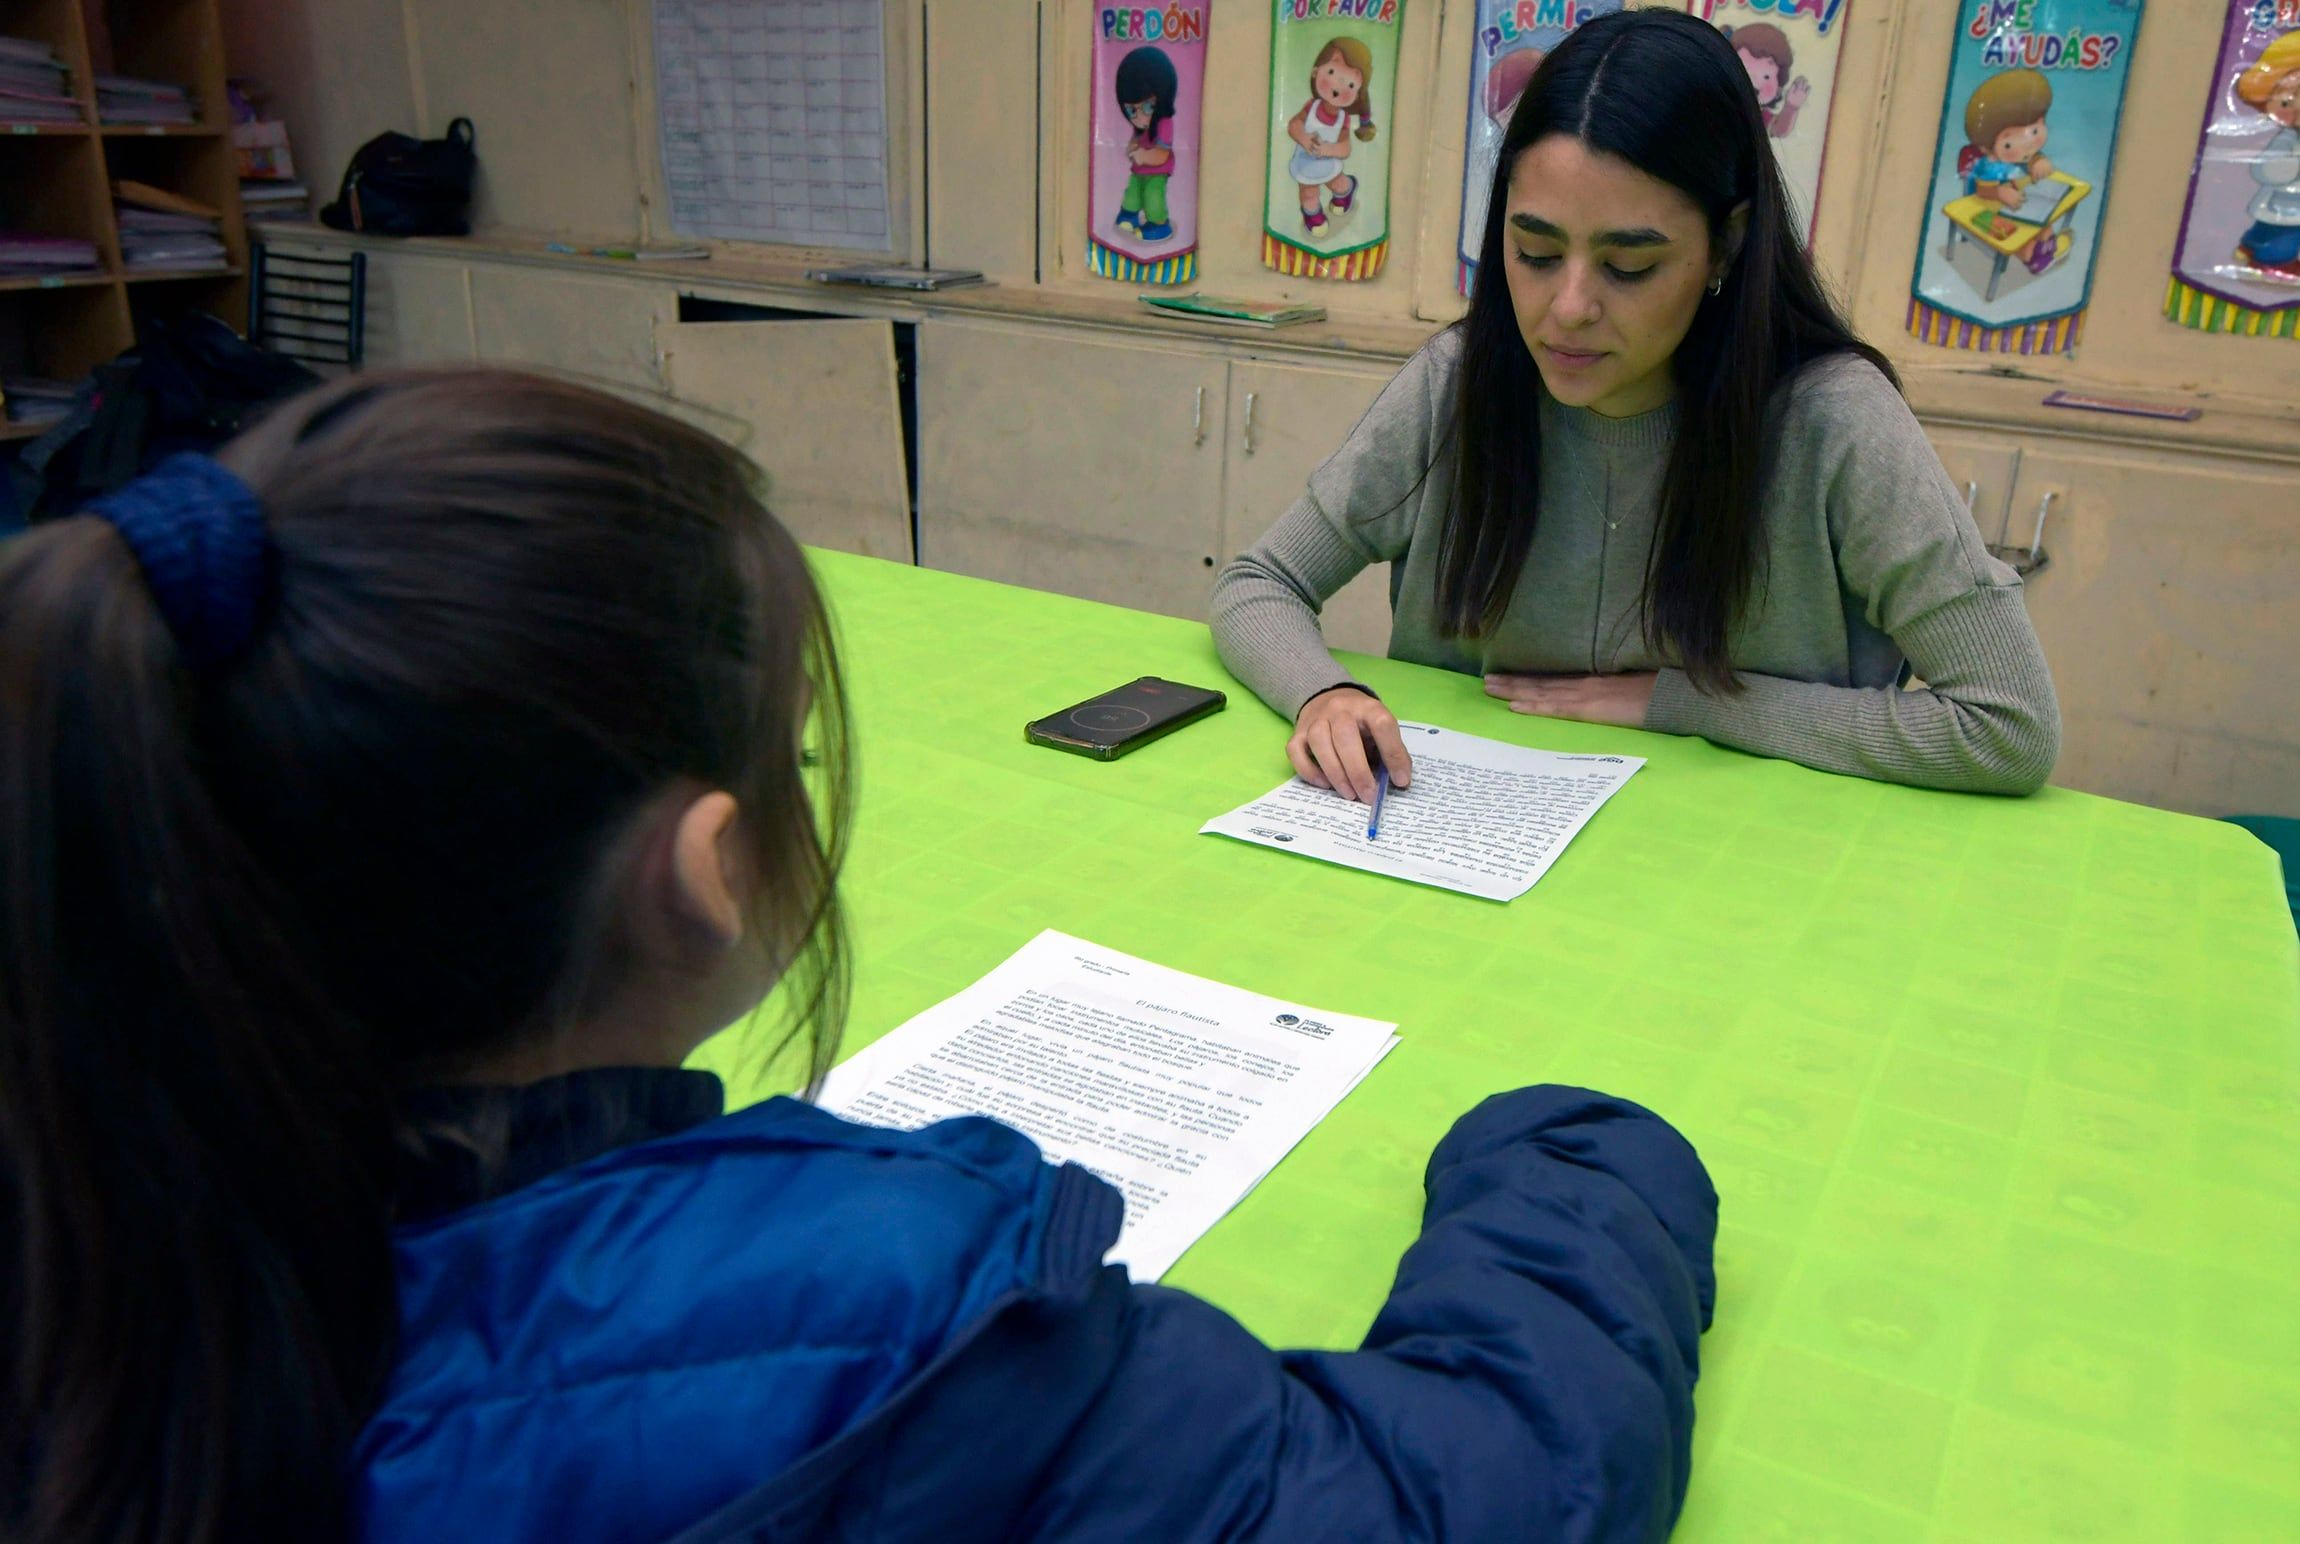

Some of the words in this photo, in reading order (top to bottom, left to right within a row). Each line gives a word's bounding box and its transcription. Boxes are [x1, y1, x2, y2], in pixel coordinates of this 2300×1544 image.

[1101, 3, 1202, 41] PERDÓN
[1281, 0, 1321, 24] POR
[1327, 0, 1398, 23] FAVOR
[1970, 0, 2034, 37] ¿ME
[1982, 26, 2120, 69] AYUDÁS?
[995, 1010, 1037, 1024] agradables
[1038, 1023, 1073, 1035] melodías
[1091, 1039, 1131, 1052] alegraban
[1017, 995, 1044, 1004] podían
[1046, 1002, 1066, 1011] tocar
[1070, 1010, 1119, 1026] instrumentos
[1050, 996, 1070, 1004] lugar
[1090, 1008, 1114, 1017] lejano
[1115, 1015, 1146, 1026] llamado
[1201, 1039, 1241, 1053] habitaban
[1244, 1051, 1281, 1065] animales
[1144, 1003, 1178, 1014] pájaro
[1179, 1011, 1219, 1026] flautista
[972, 1024, 1012, 1040] admiraban
[1010, 1000, 1034, 1009] zorros
[1127, 1034, 1147, 1042] ellos
[1148, 1039, 1177, 1050] llevaba
[1191, 1052, 1239, 1068] instrumento
[1241, 1066, 1275, 1078] colgado
[1071, 1025, 1098, 1035] minuto
[1129, 1042, 1172, 1056] entonaban
[1173, 1054, 1198, 1064] bellas
[955, 1061, 998, 1076] distinguido
[997, 1074, 1025, 1085] pájaro
[1026, 1083, 1074, 1100] manipulaba
[967, 1039, 1004, 1053] alrededor
[1005, 1052, 1048, 1067] entonando
[1049, 1066, 1091, 1080] canciones
[1092, 1079, 1144, 1097] maravillosas
[1207, 1112, 1242, 1126] Cuando
[972, 1033, 999, 1043] pájaro
[1015, 1046, 1047, 1059] invitado
[1056, 1059, 1079, 1068] todas
[1095, 1070, 1122, 1082] fiestas
[1132, 1082, 1166, 1094] siempre
[1167, 1093, 1205, 1106] animaba
[1216, 1106, 1240, 1117] todos
[995, 1024, 1018, 1033] aquel
[1049, 1041, 1067, 1049] vivía
[1086, 1053, 1113, 1062] pájaro
[1118, 1061, 1150, 1074] flautista
[1177, 1079, 1210, 1090] popular
[1238, 1095, 1262, 1106] todos
[950, 1051, 998, 1068] abarrotaban
[1000, 1066, 1024, 1076] cerca
[1049, 1082, 1081, 1094] entrada
[1104, 1100, 1130, 1110] poder
[1133, 1109, 1167, 1121] admirar
[1180, 1123, 1208, 1134] gracia
[1026, 1066, 1062, 1080] entradas
[1075, 1082, 1114, 1096] agotaban
[1193, 1118, 1235, 1133] personas
